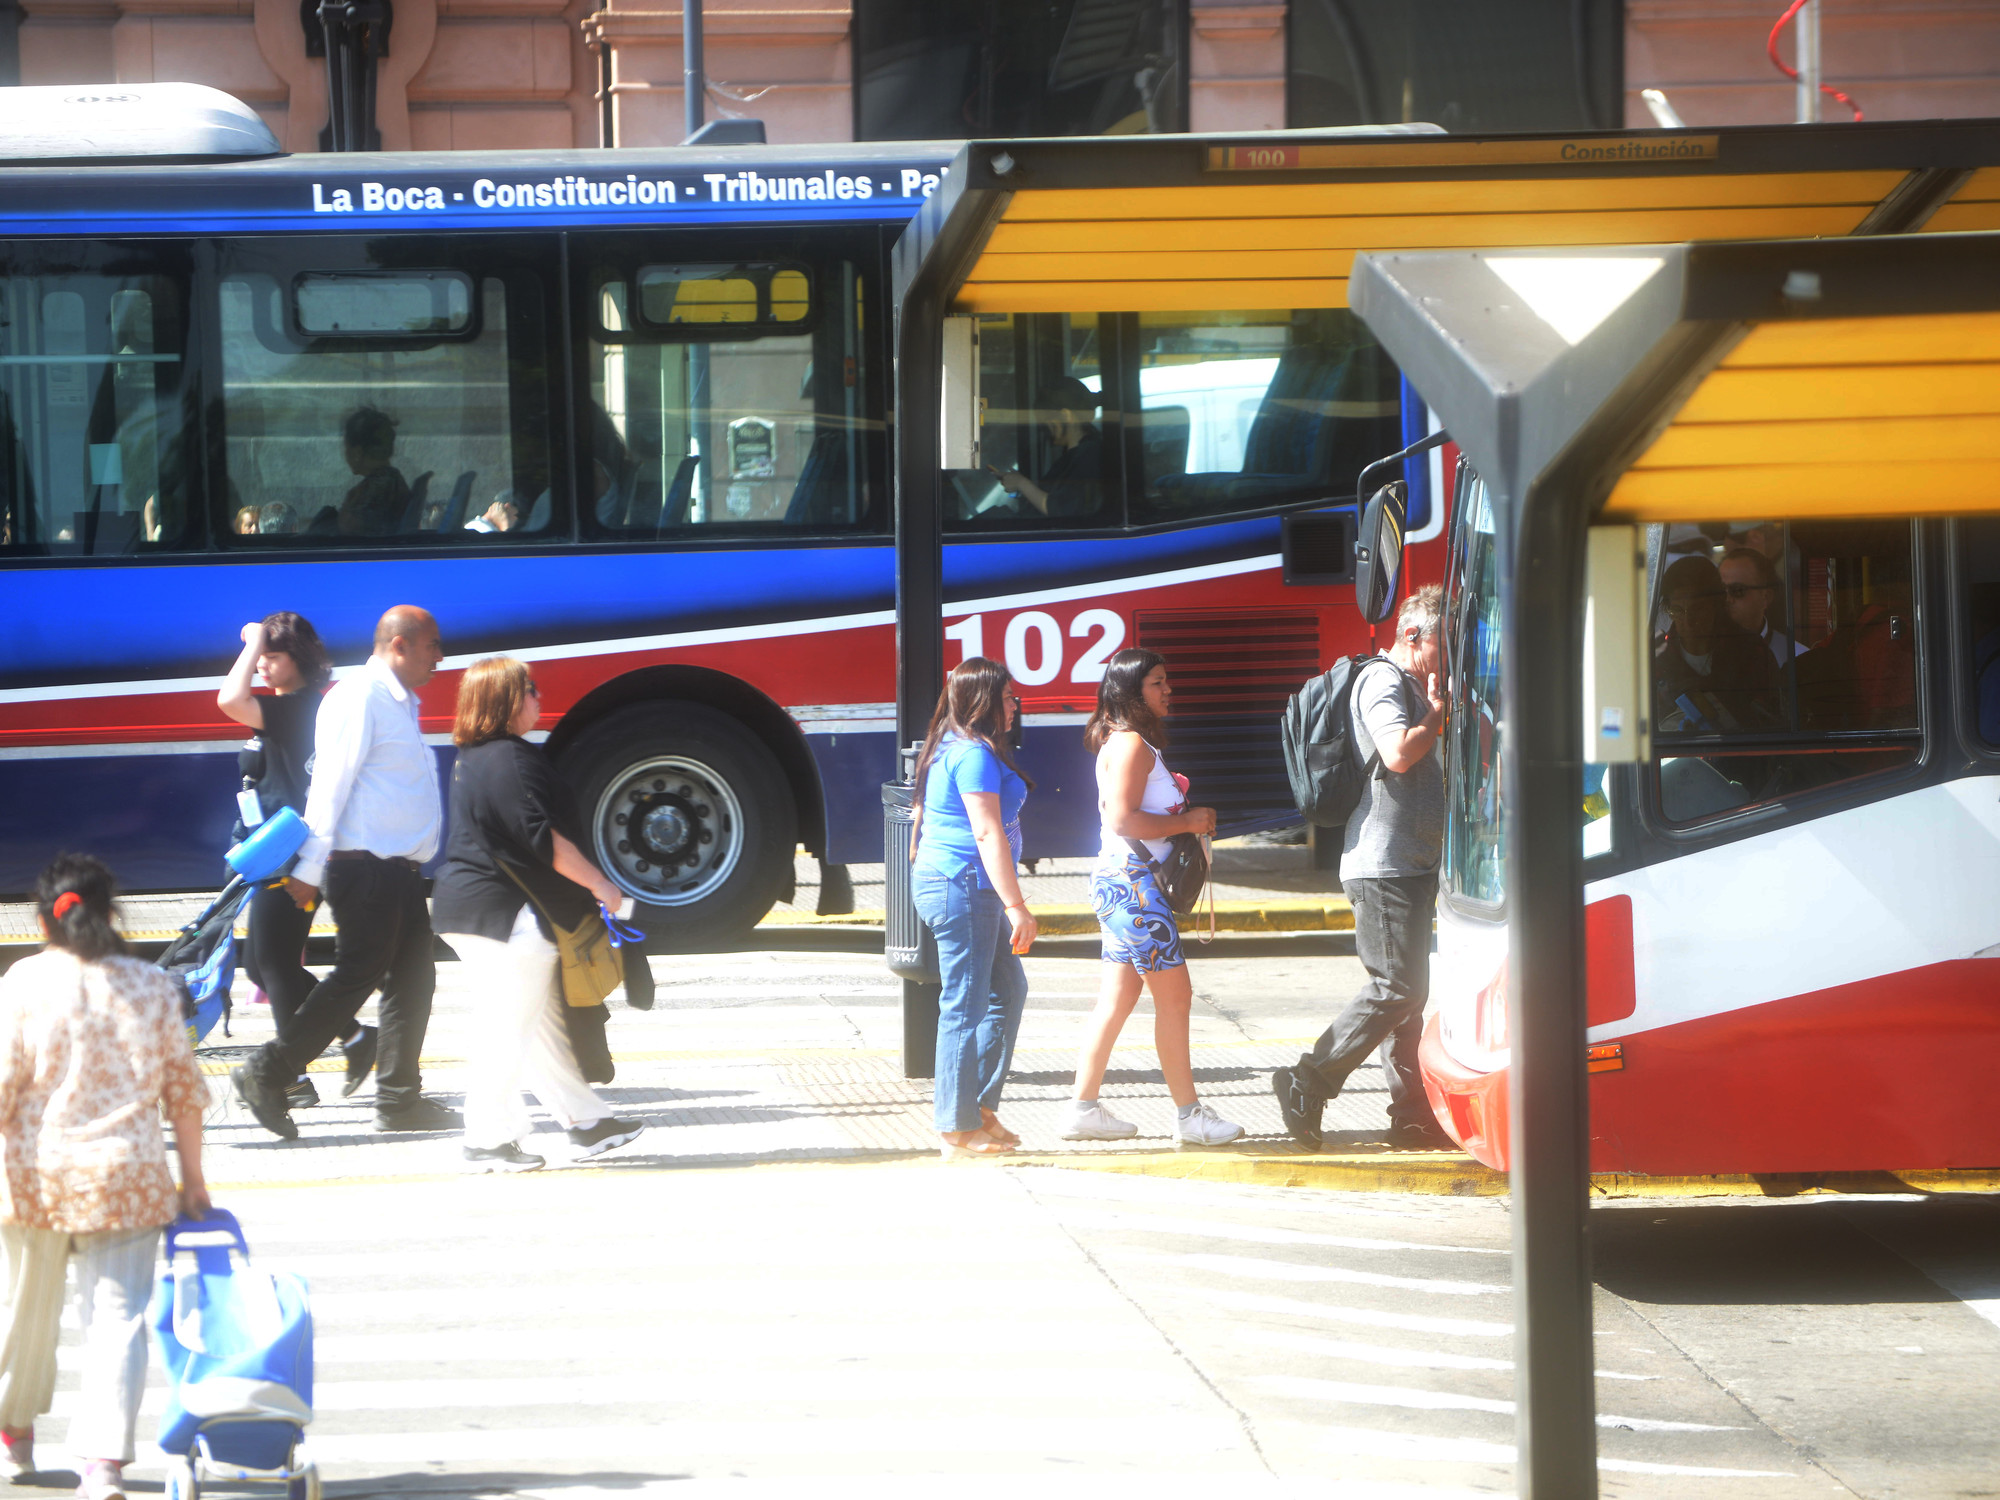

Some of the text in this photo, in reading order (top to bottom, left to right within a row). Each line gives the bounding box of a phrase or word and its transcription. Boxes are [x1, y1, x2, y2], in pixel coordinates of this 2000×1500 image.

[1247, 139, 1704, 167] 100 Constitución
[312, 183, 354, 212] La
[361, 182, 446, 211] Boca
[473, 174, 676, 208] Constitucion
[703, 169, 873, 202] Tribunales
[945, 608, 1126, 686] 102
